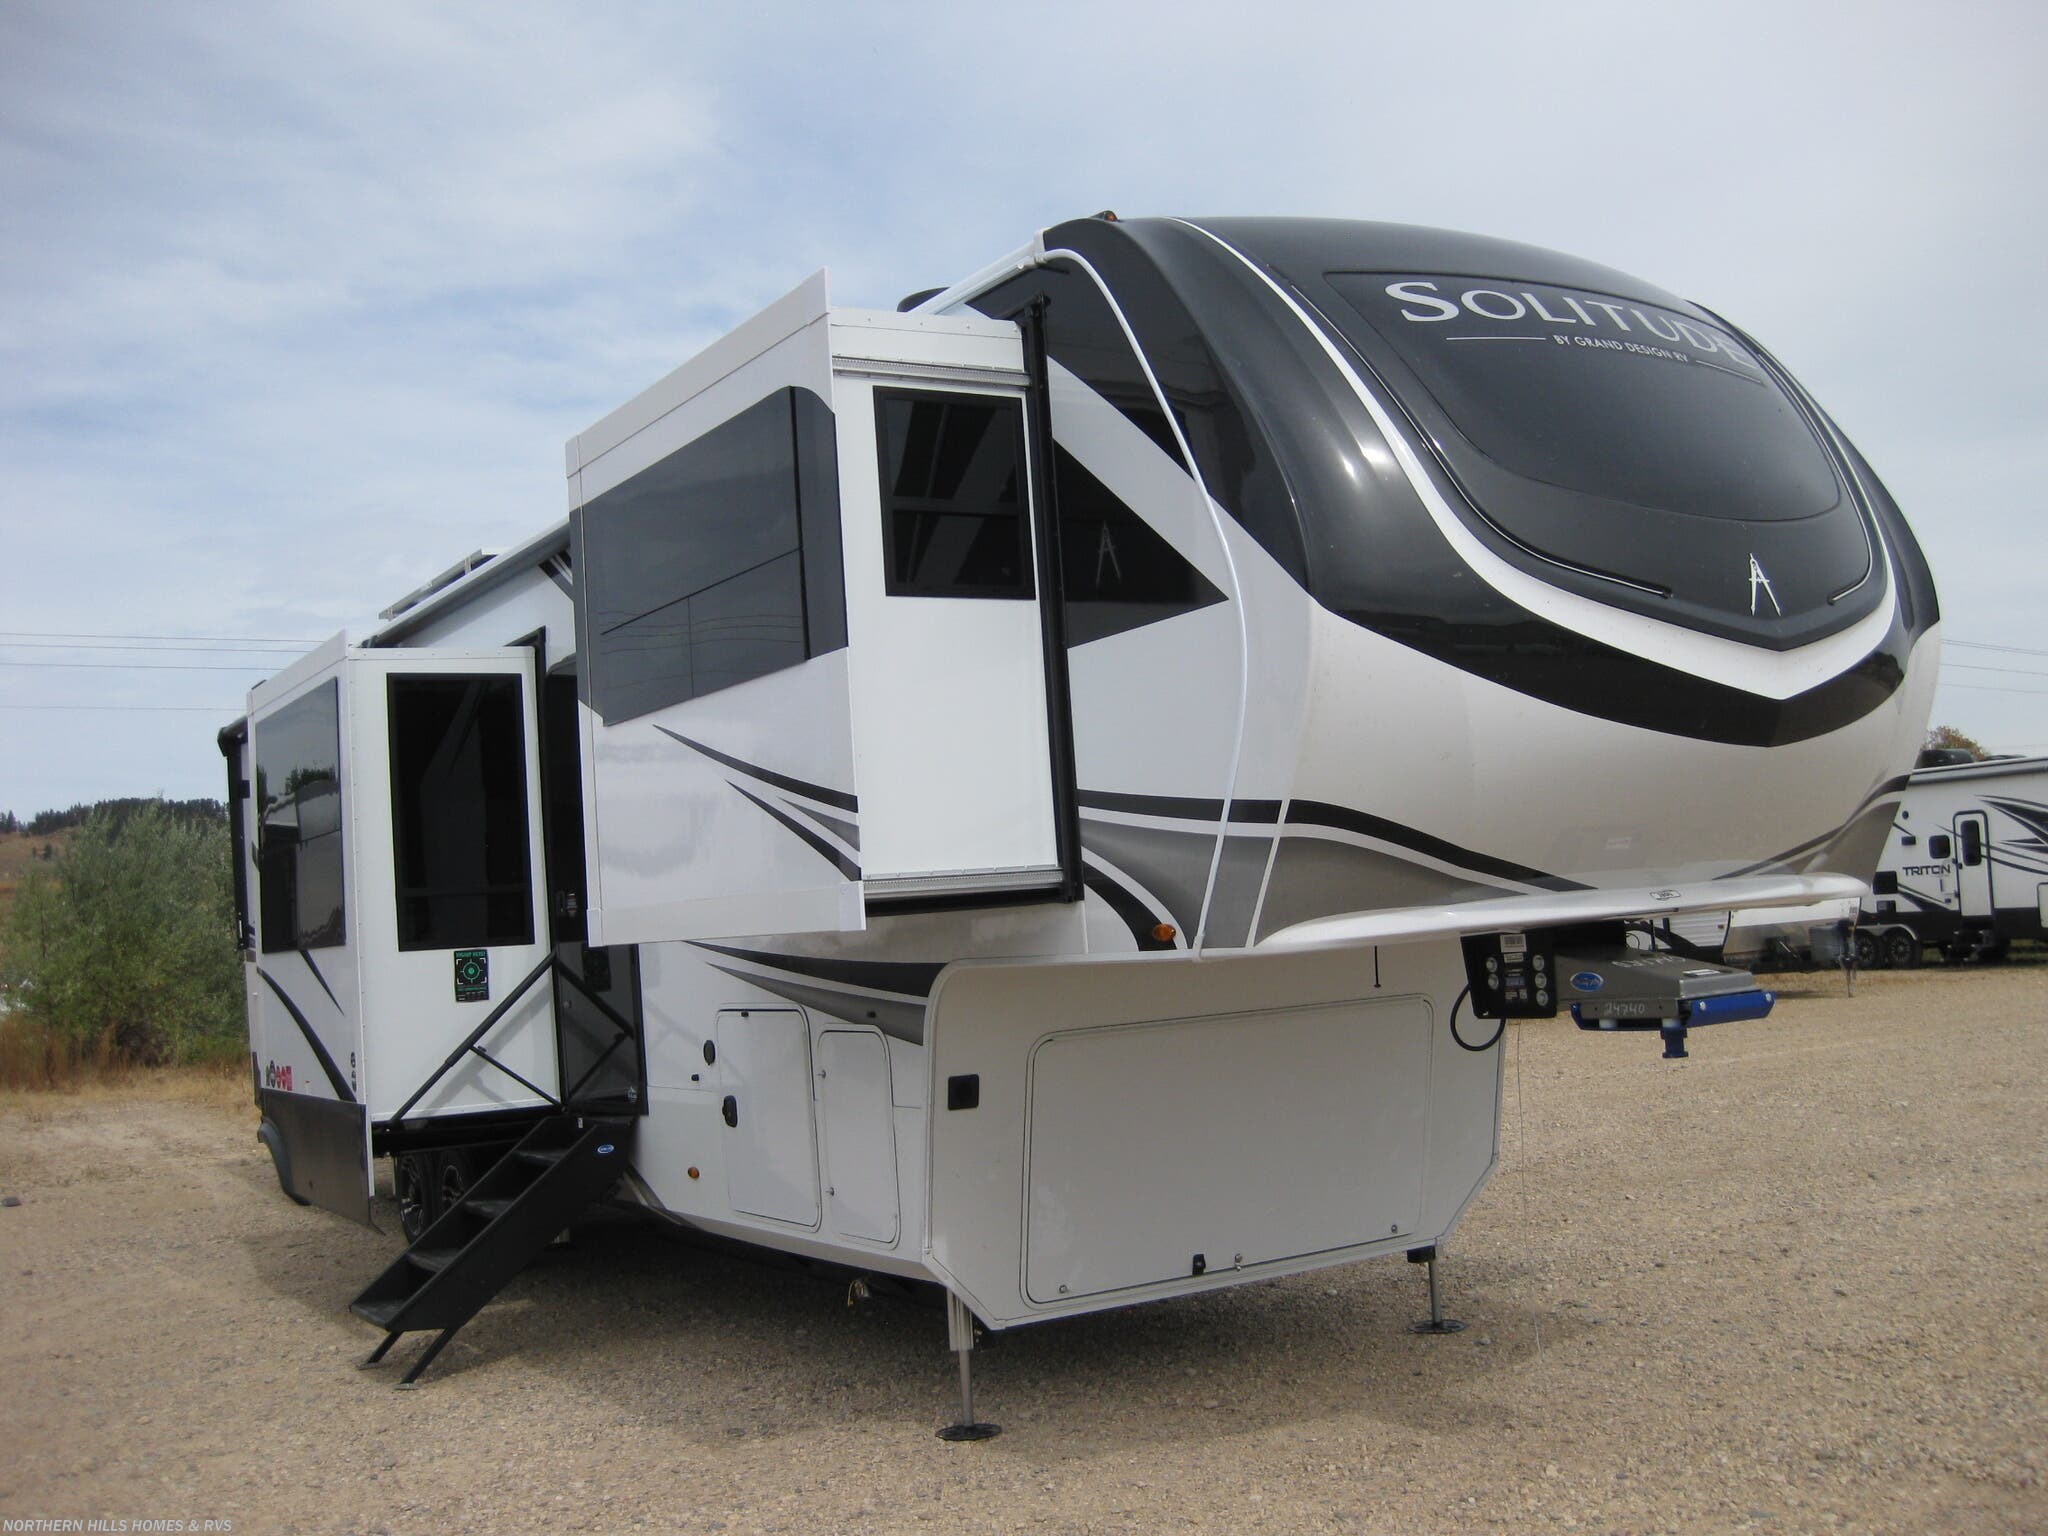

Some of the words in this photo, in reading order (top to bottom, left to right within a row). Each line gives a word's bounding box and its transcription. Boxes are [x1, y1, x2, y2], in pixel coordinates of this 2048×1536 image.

[1385, 281, 1758, 369] SOLITUDE
[1552, 334, 1571, 346] BY
[1573, 336, 1624, 351] GRAND
[1623, 341, 1674, 359] DESIGN
[1902, 864, 1951, 876] TRITON
